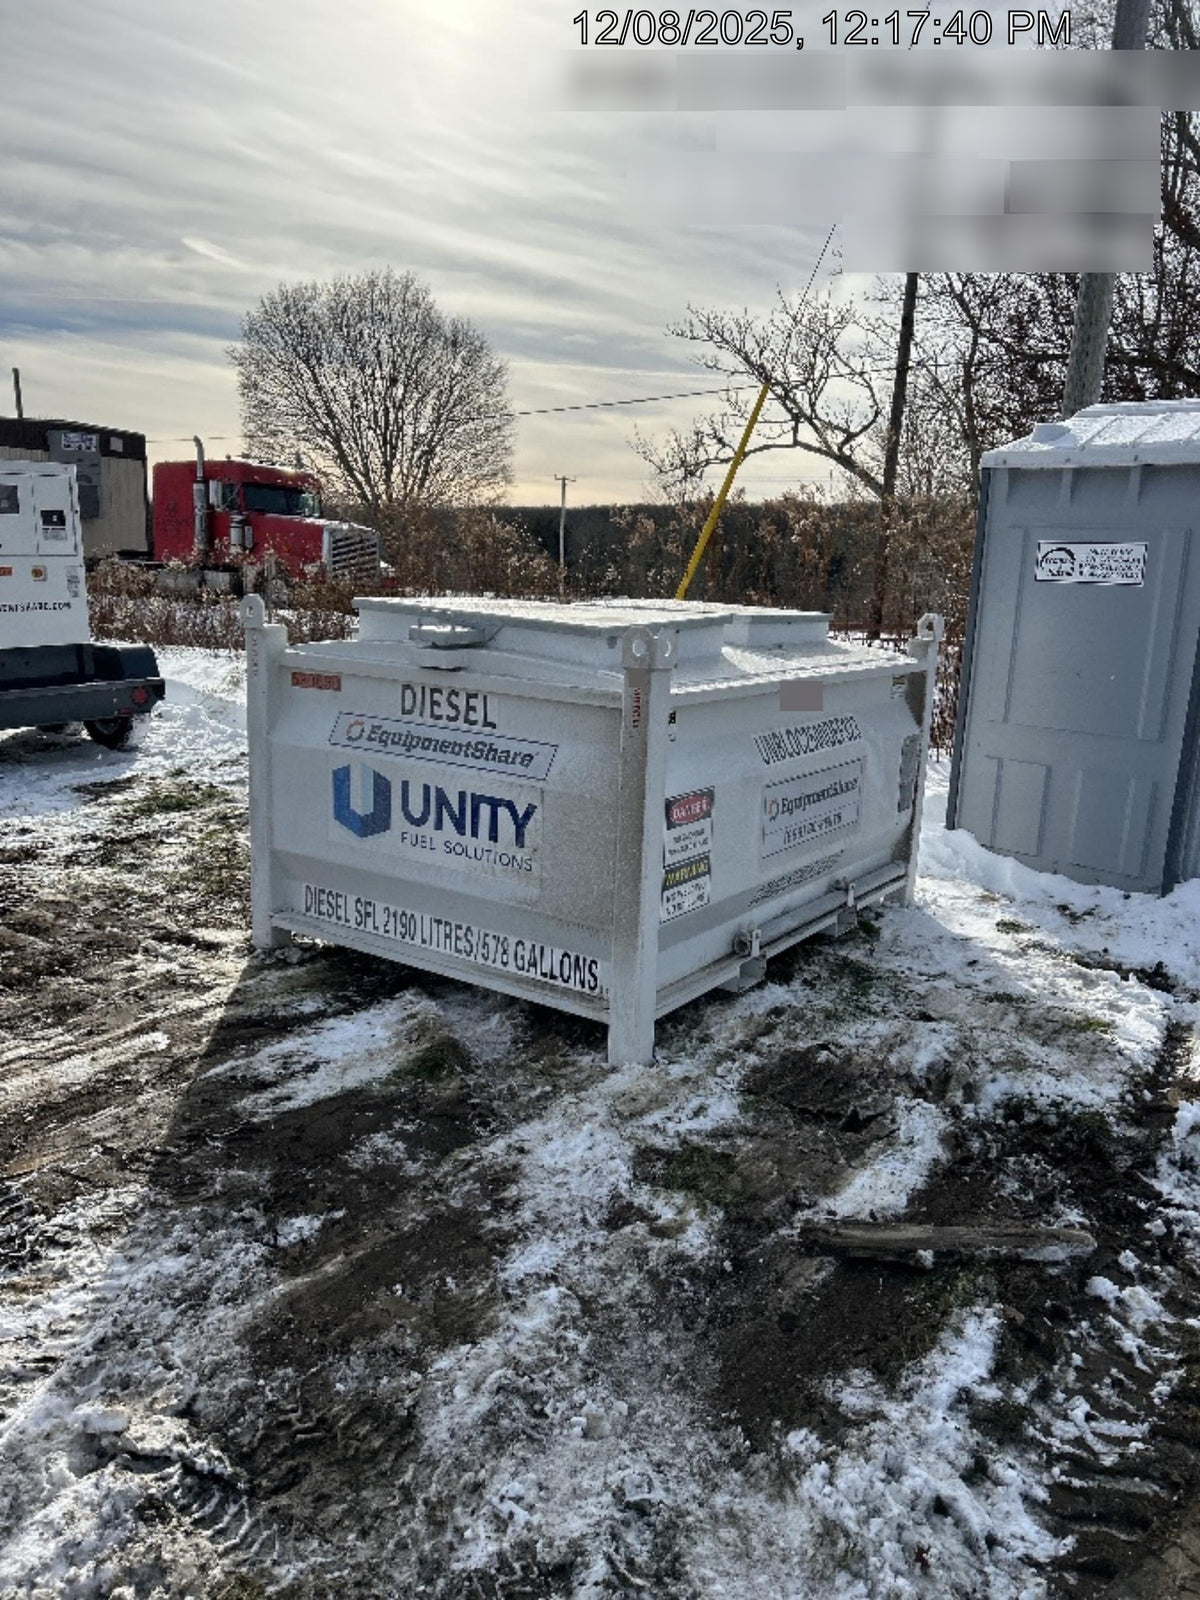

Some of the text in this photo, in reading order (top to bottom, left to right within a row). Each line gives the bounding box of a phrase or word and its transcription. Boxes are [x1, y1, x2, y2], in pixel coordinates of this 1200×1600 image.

[0, 601, 72, 613] ENTSHARE.COM
[401, 684, 497, 729] DIESEL
[366, 724, 534, 768] EquipmentShare
[401, 780, 538, 848] UNITY
[401, 832, 533, 872] FUEL SOLUTIONS
[305, 884, 350, 923] DIESEL
[355, 897, 379, 932] SFL
[383, 906, 417, 941] 2190
[514, 940, 598, 991] GALLONS
